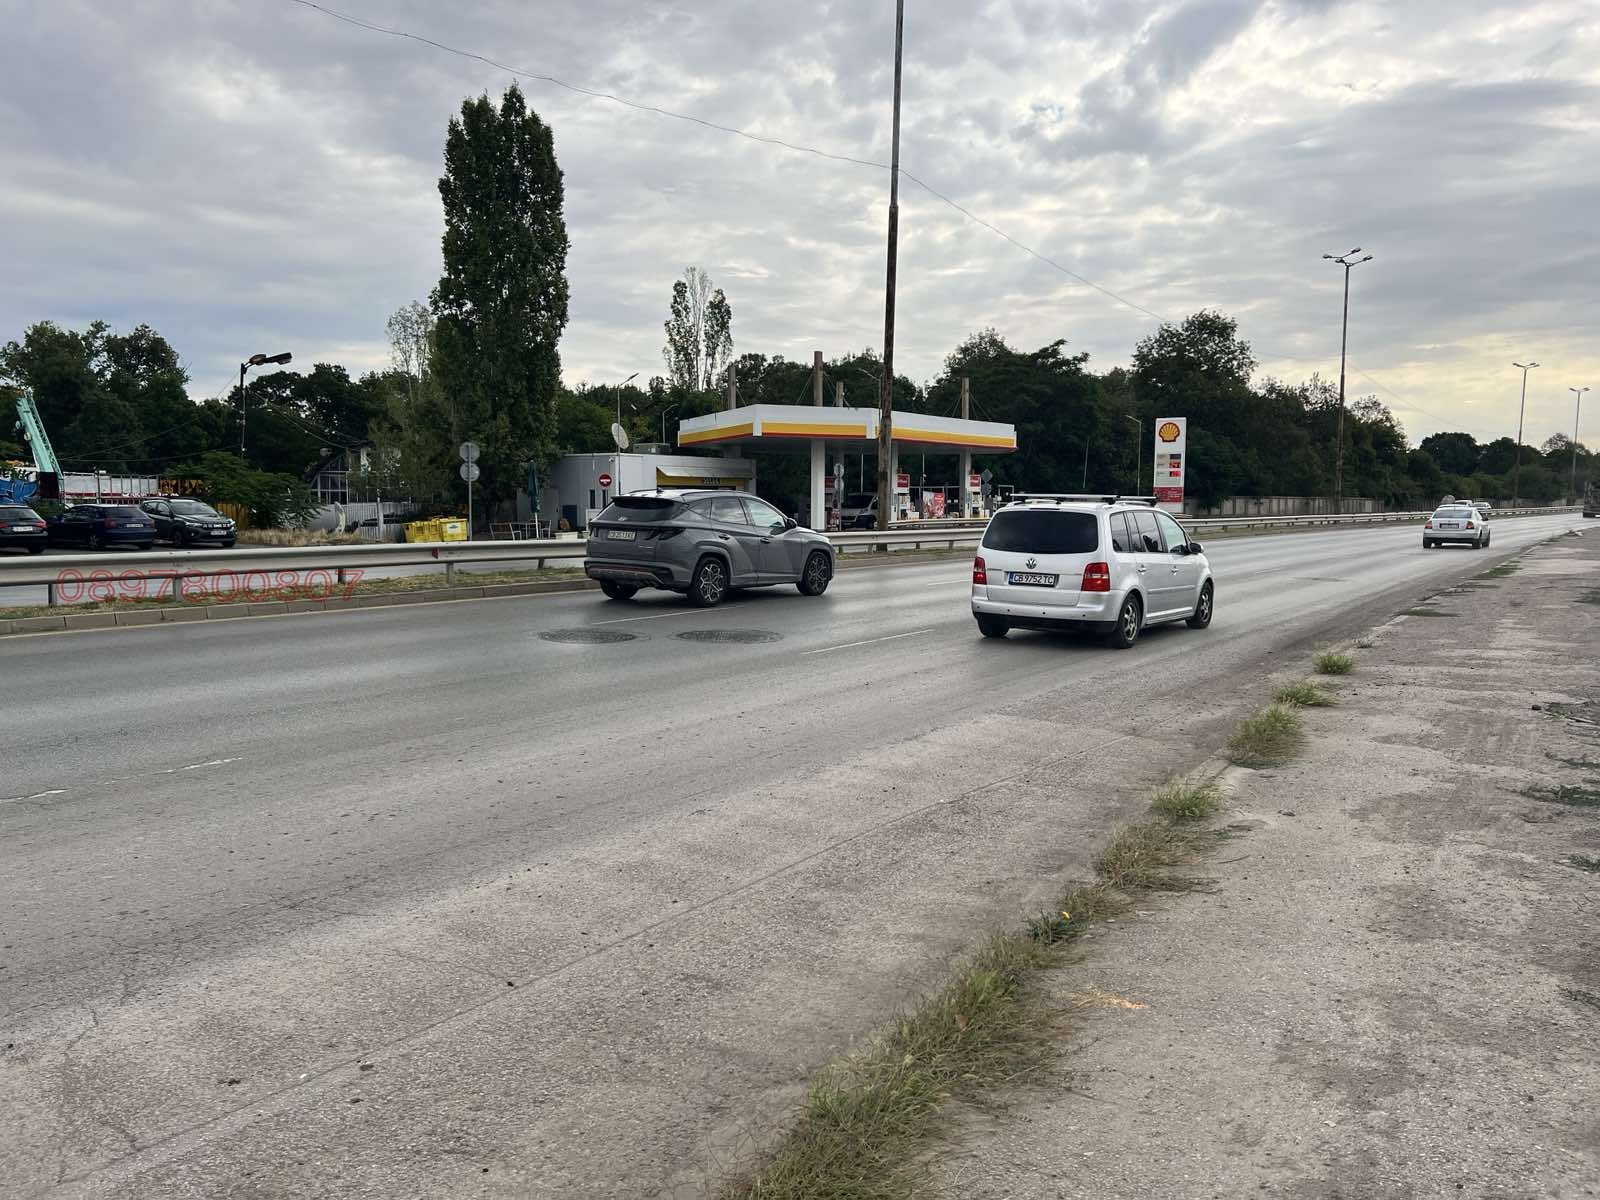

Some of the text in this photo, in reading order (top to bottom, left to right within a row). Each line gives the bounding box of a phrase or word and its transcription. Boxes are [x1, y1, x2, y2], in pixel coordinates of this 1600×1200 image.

[1013, 574, 1054, 584] CB 9752 TC
